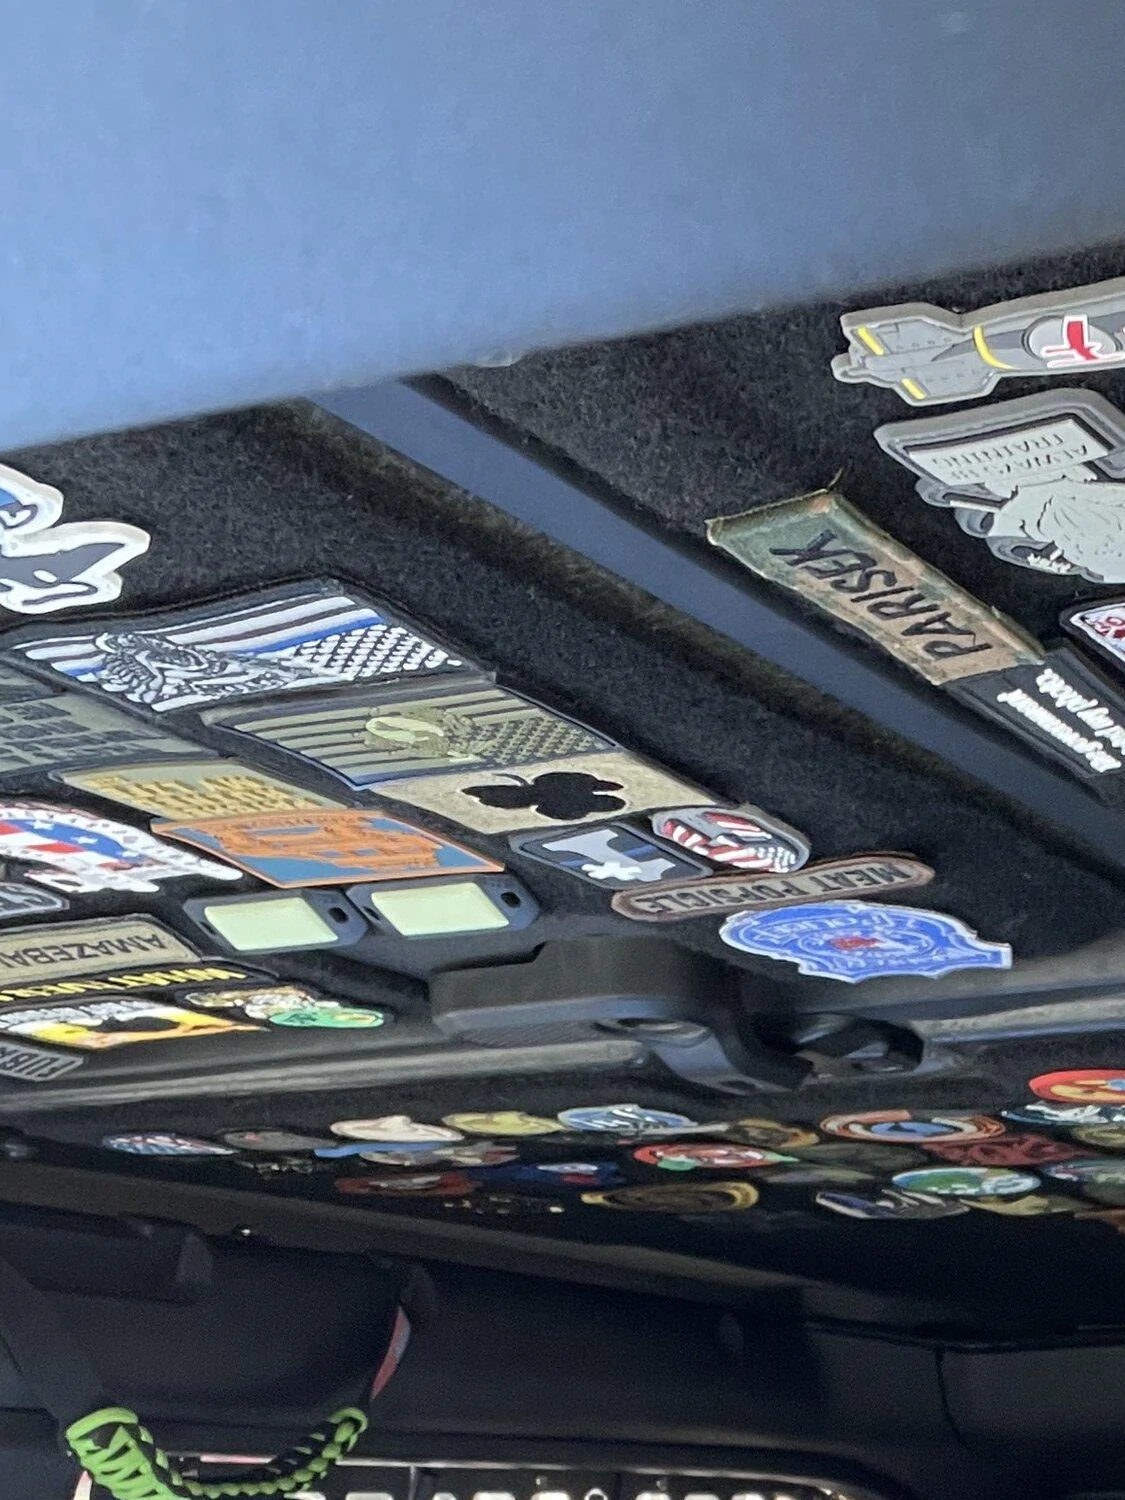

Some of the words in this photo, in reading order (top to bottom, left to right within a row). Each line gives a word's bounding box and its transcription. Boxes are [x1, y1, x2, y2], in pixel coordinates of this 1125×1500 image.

[769, 529, 994, 661] PARISEK
[813, 863, 912, 893] MEAT
[635, 880, 810, 914] POPSICLE
